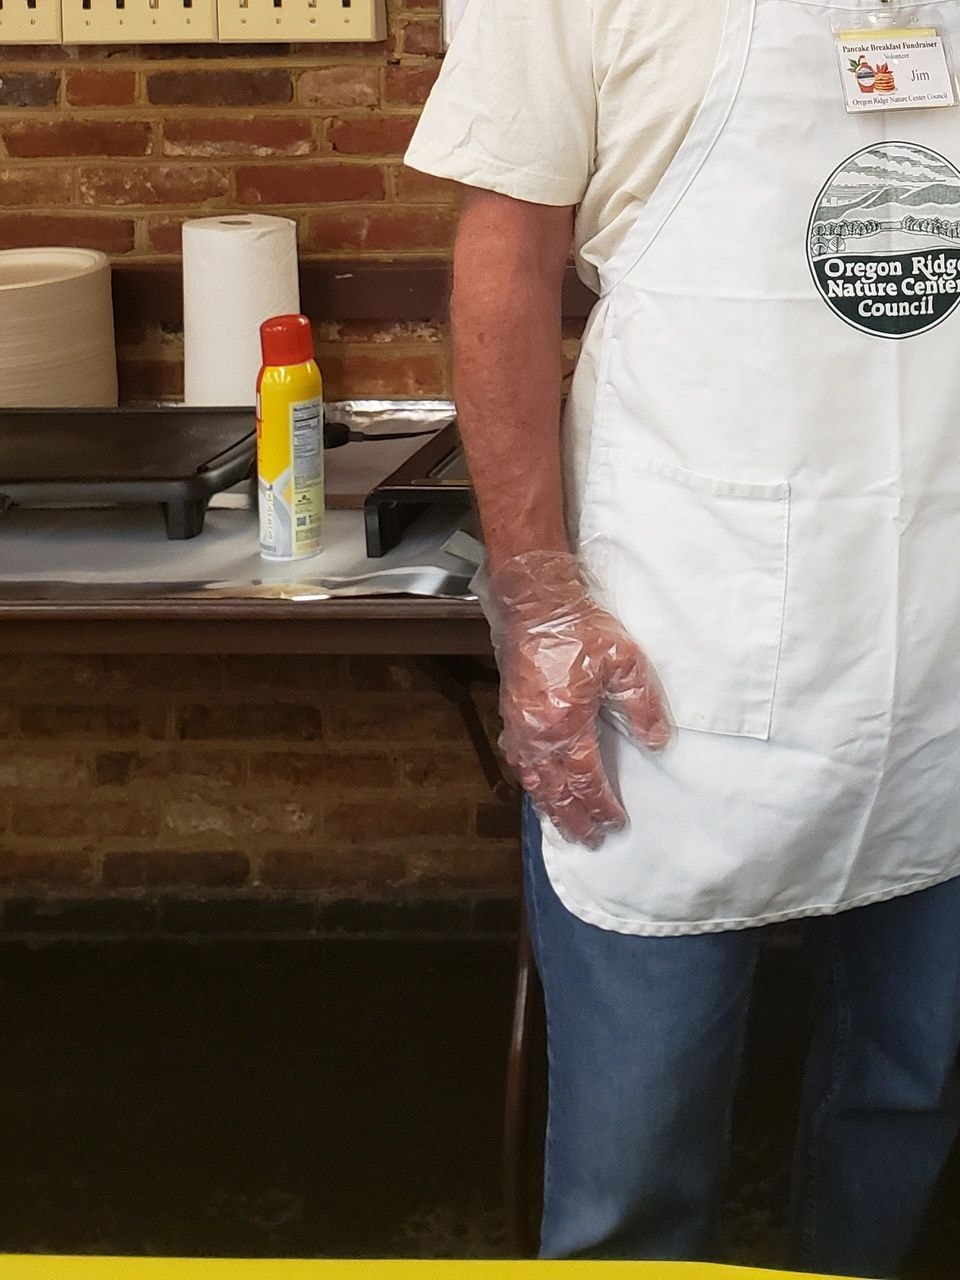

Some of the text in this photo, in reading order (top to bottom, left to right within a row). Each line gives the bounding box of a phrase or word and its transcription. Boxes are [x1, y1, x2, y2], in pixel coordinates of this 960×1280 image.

[842, 40, 938, 53] Pancake Breakfast Fundraiser
[884, 52, 910, 61] Volunteer
[910, 68, 930, 81] Jim
[852, 99, 873, 107] Oregon
[873, 97, 889, 106] Ridge
[908, 94, 926, 102] Center
[927, 92, 948, 100] Council
[824, 259, 902, 283] Oregon
[827, 280, 898, 298] Nature
[858, 296, 934, 317] Council
